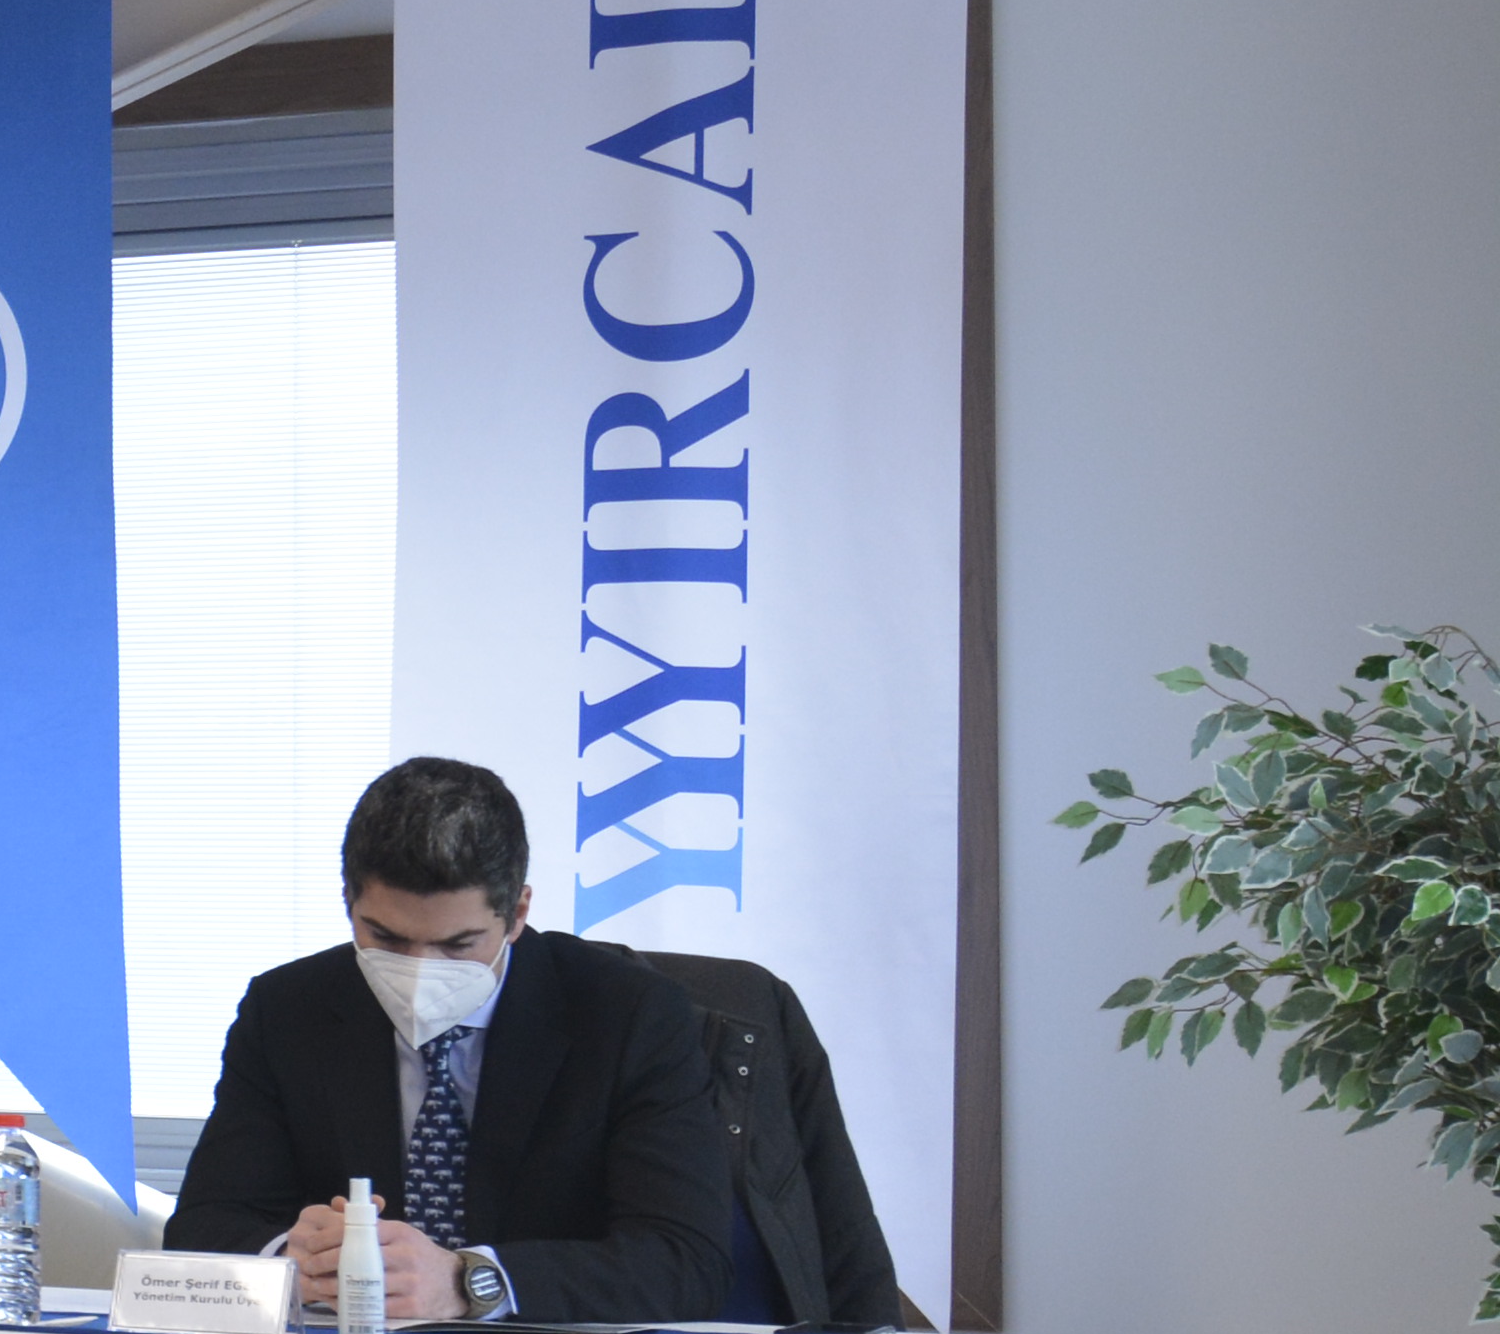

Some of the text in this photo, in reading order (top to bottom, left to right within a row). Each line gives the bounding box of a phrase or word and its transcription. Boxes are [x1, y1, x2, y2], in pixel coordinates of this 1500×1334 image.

[141, 1274, 181, 1287] Ömer
[185, 1278, 220, 1290] Şerif
[133, 1292, 186, 1303] Yönetim
[190, 1294, 232, 1305] Kurulu
